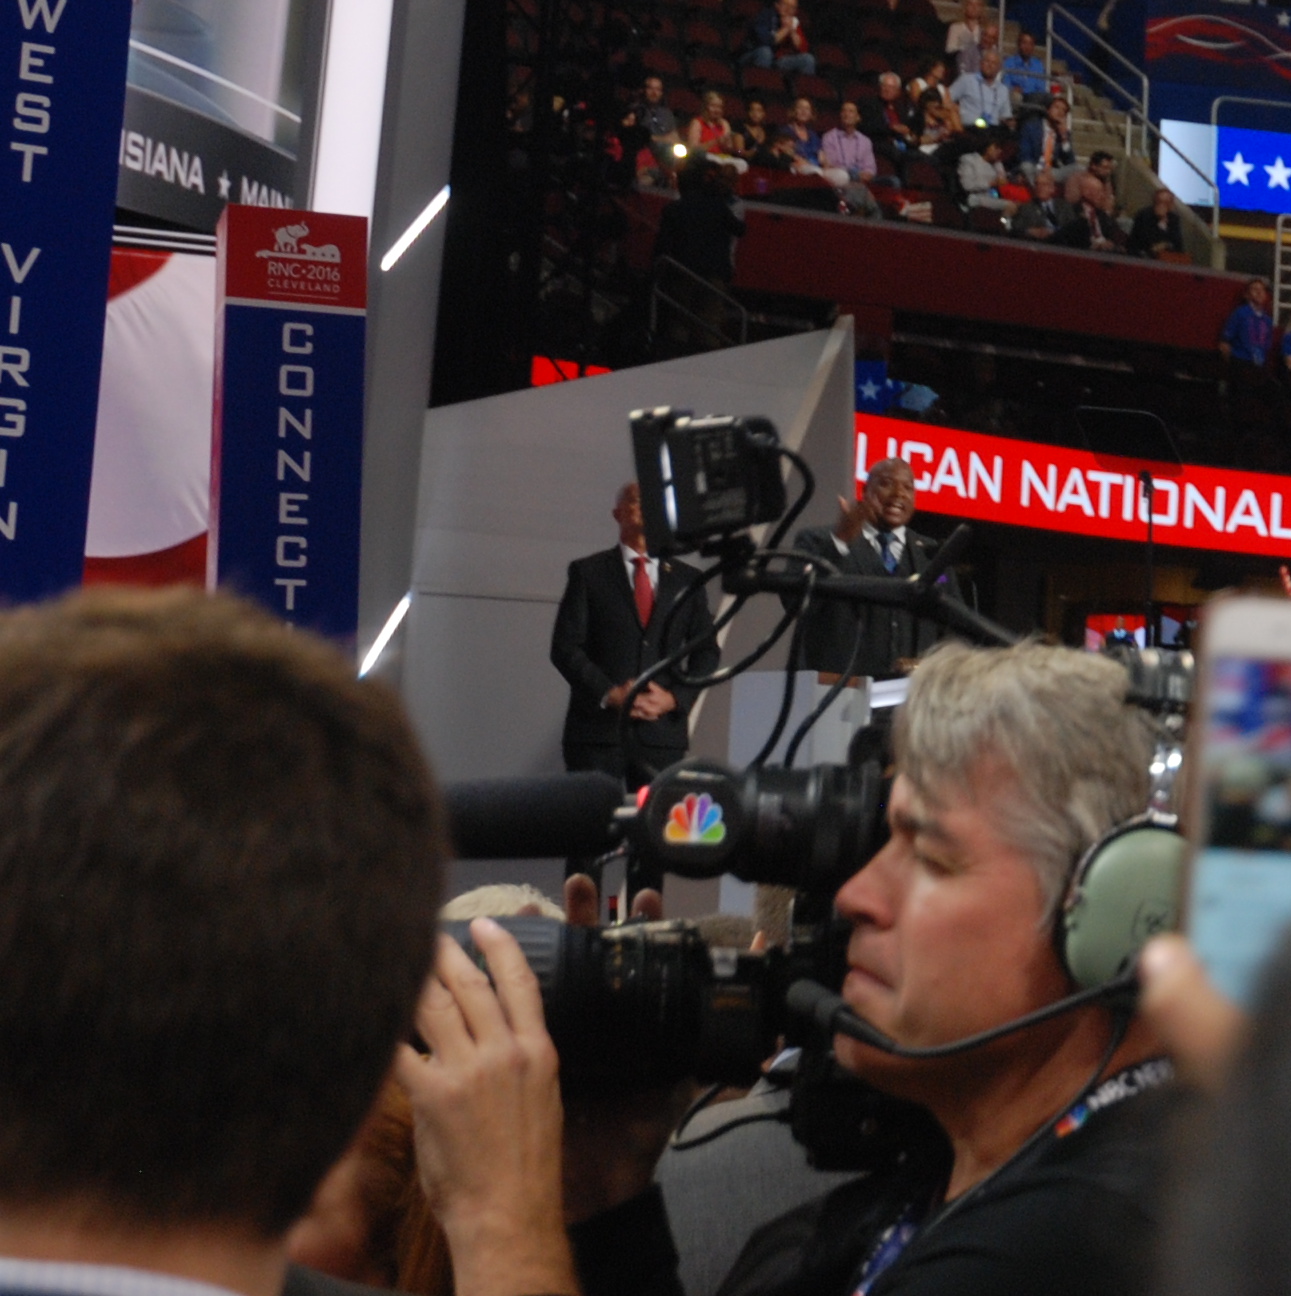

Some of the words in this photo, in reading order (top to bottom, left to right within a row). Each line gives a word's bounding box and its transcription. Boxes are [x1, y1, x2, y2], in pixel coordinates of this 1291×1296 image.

[241, 175, 296, 210] MAIN
[266, 261, 302, 279] RNC
[305, 263, 342, 283] 2016
[266, 277, 342, 294] CLEVELAND
[274, 322, 315, 626] CONNECT
